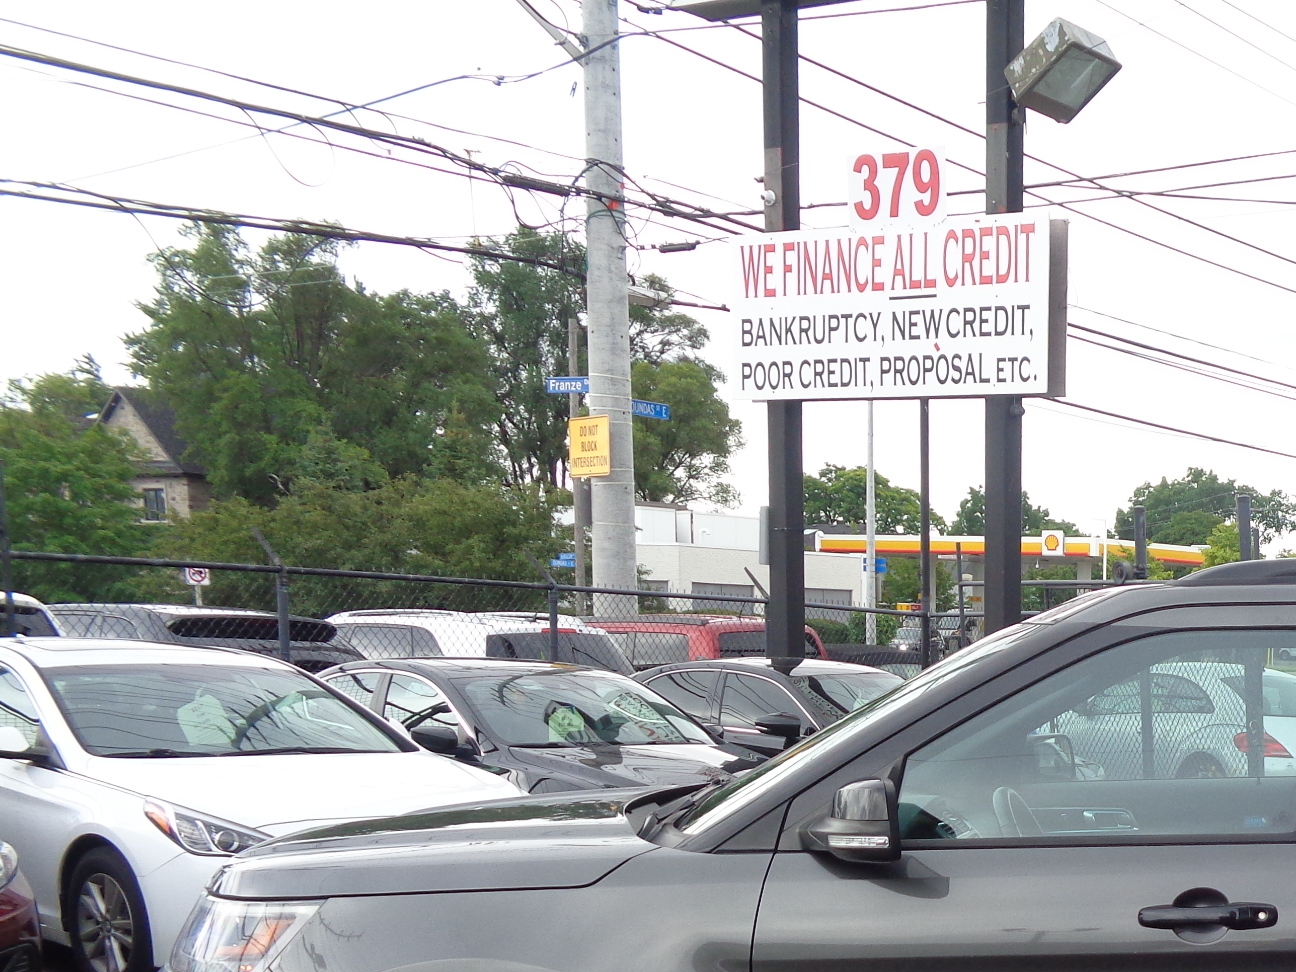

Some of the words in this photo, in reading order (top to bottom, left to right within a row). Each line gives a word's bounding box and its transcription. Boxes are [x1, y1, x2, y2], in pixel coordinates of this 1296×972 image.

[852, 149, 940, 220] 379
[740, 243, 776, 298] WE
[782, 236, 885, 296] FINANCE
[890, 231, 937, 292] ALL
[943, 223, 1036, 287] CREDIT
[741, 312, 886, 348] BANKRUPTCY,
[891, 308, 943, 341] NEW
[945, 304, 1034, 342] CREDIT,
[741, 360, 794, 391] POOR
[798, 356, 874, 392] CREDIT,
[880, 352, 991, 387] PROPOSAL
[996, 355, 1038, 383] ETC.
[549, 379, 582, 391] Franze
[662, 406, 667, 418] E
[579, 426, 586, 437] DO
[587, 424, 599, 437] NOT
[581, 440, 598, 452] BLOCK
[571, 455, 608, 469] INTERSECTION
